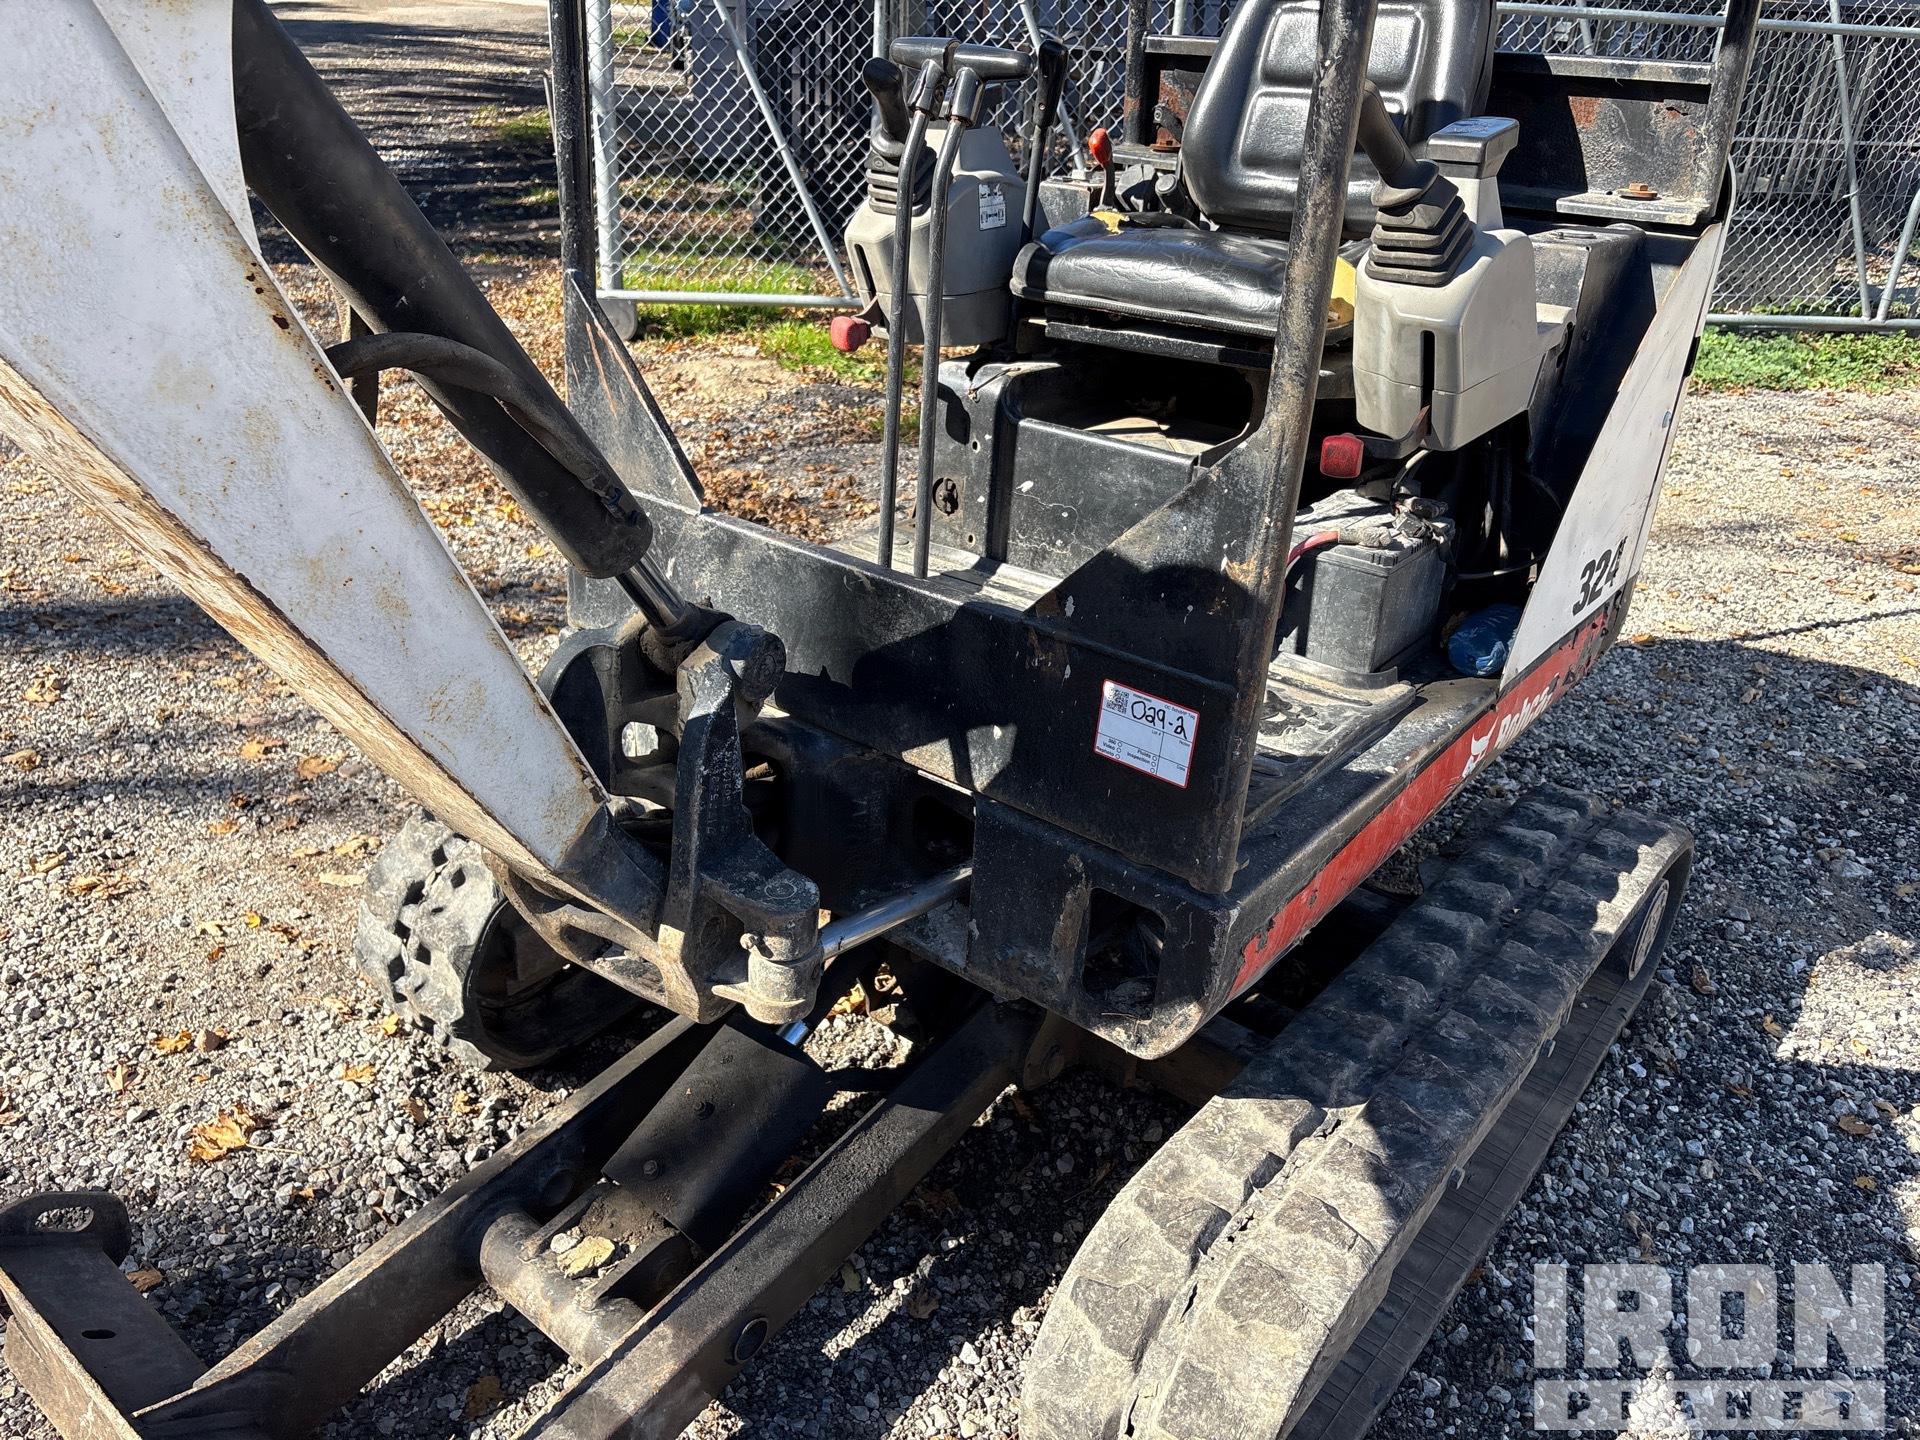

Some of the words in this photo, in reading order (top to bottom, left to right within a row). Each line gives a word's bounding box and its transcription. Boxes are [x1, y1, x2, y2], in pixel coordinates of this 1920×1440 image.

[1572, 536, 1628, 616] 324
[1102, 741, 1115, 750] Video
[1126, 752, 1150, 765] Inspection
